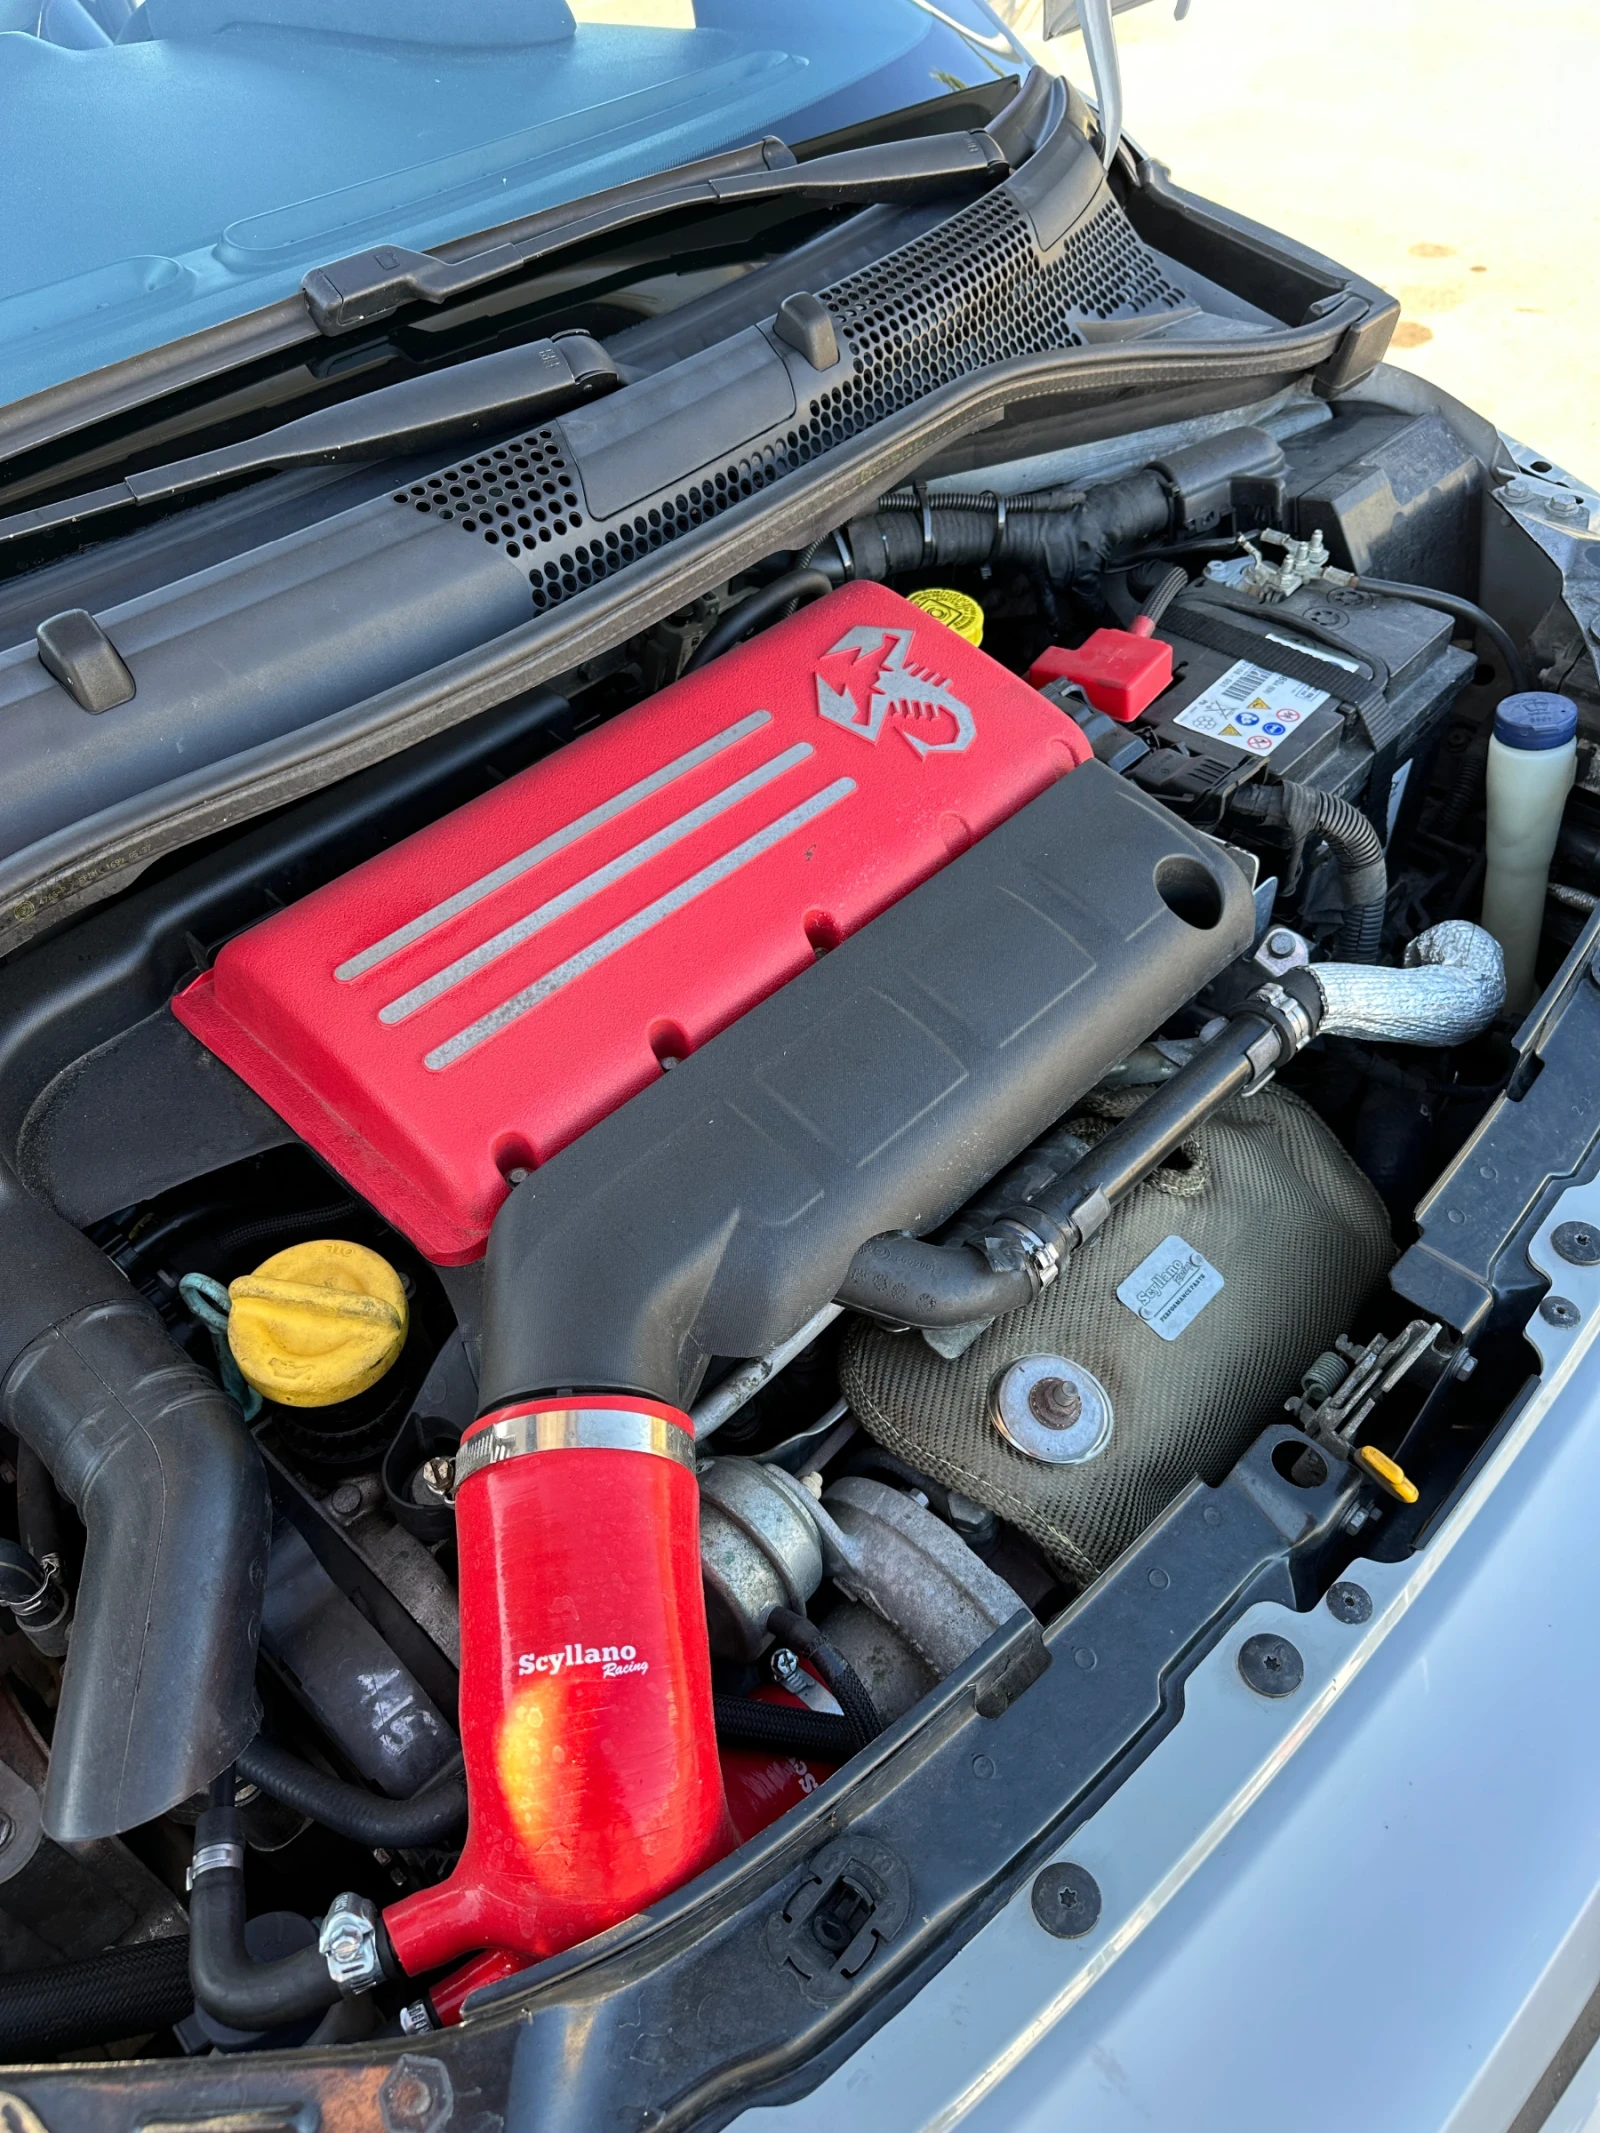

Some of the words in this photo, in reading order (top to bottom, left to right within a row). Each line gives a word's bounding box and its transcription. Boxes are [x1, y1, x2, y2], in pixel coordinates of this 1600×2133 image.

[1136, 1260, 1183, 1306] Scyllano
[1160, 1289, 1192, 1323] PERFORMANCE
[1190, 1273, 1206, 1291] PARTS
[518, 1643, 637, 1676] Scyllano
[602, 1660, 649, 1679] Racing
